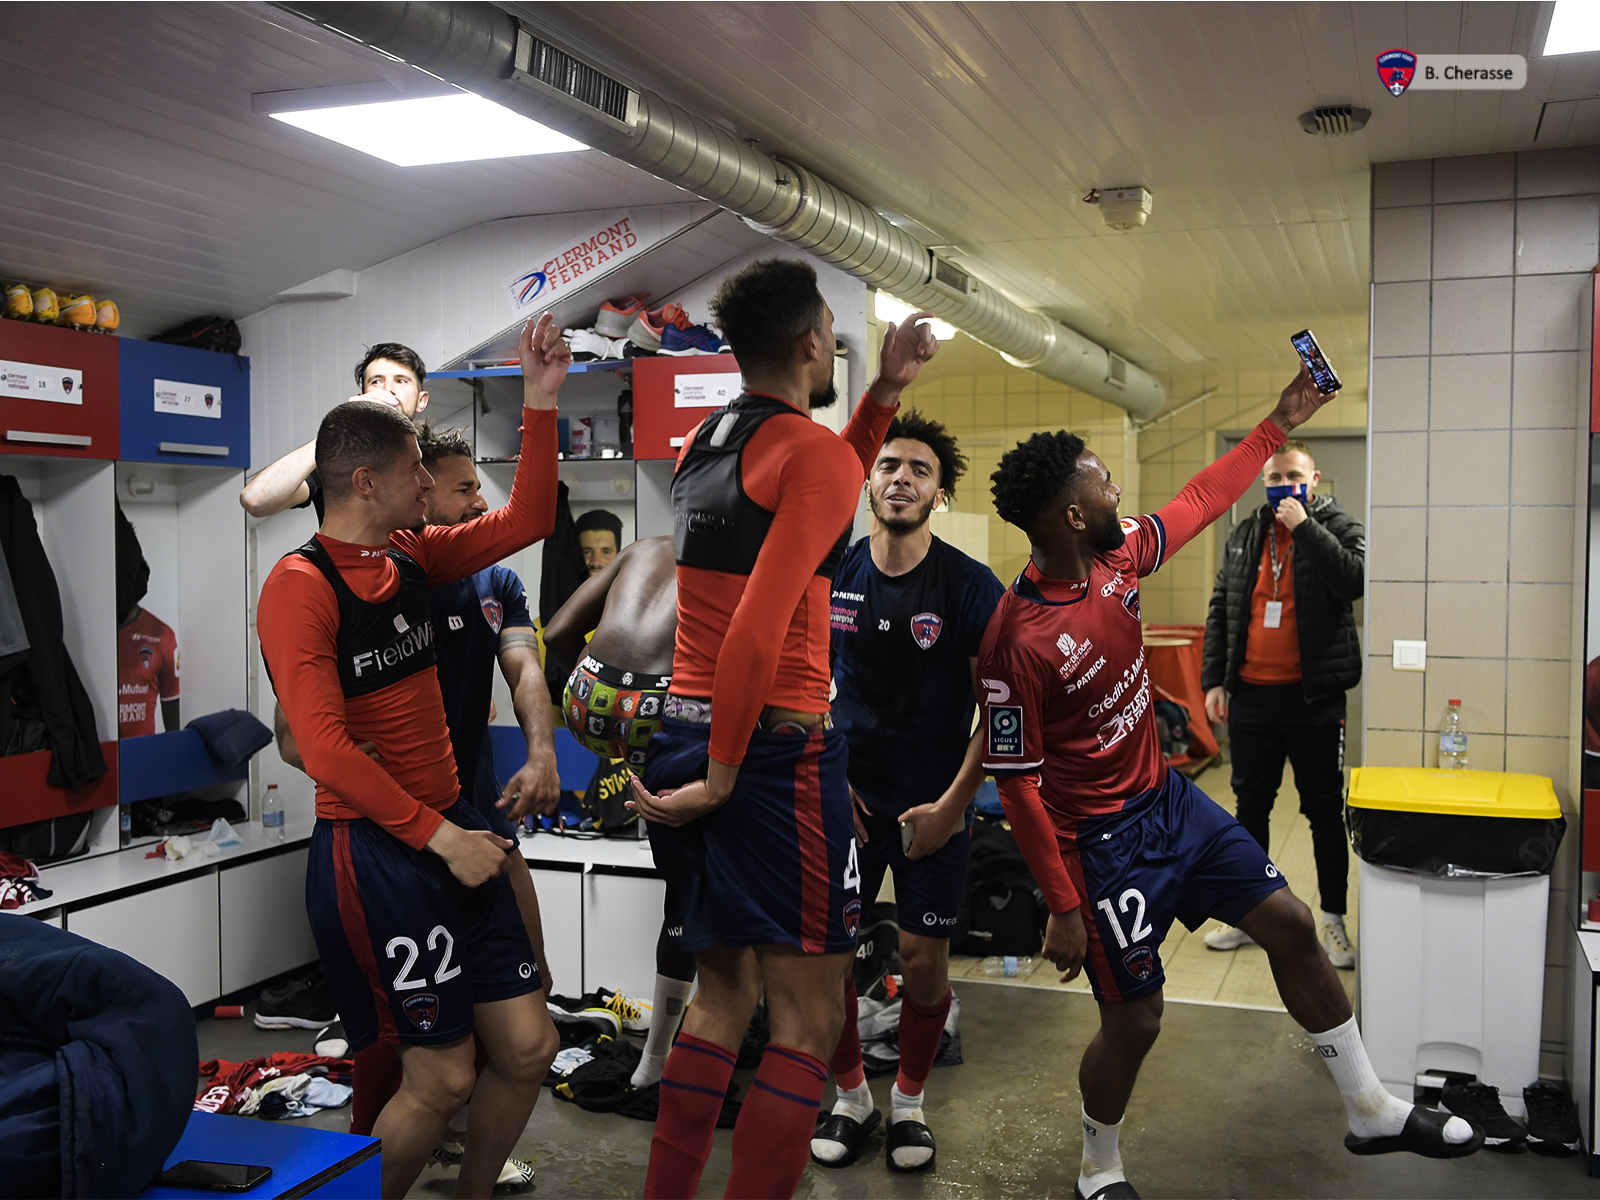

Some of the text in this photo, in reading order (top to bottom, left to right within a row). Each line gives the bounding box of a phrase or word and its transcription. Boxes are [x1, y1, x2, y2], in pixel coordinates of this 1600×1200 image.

[541, 217, 631, 276] CLERMONT
[548, 232, 637, 290] FERRAND
[38, 380, 47, 388] 18
[838, 591, 865, 603] PATRICK
[878, 618, 891, 632] 20
[1076, 655, 1107, 690] PATRICK
[1088, 680, 1125, 718] Crédit
[1097, 888, 1153, 950] 12
[385, 924, 462, 991] 22
[856, 940, 874, 960] 40
